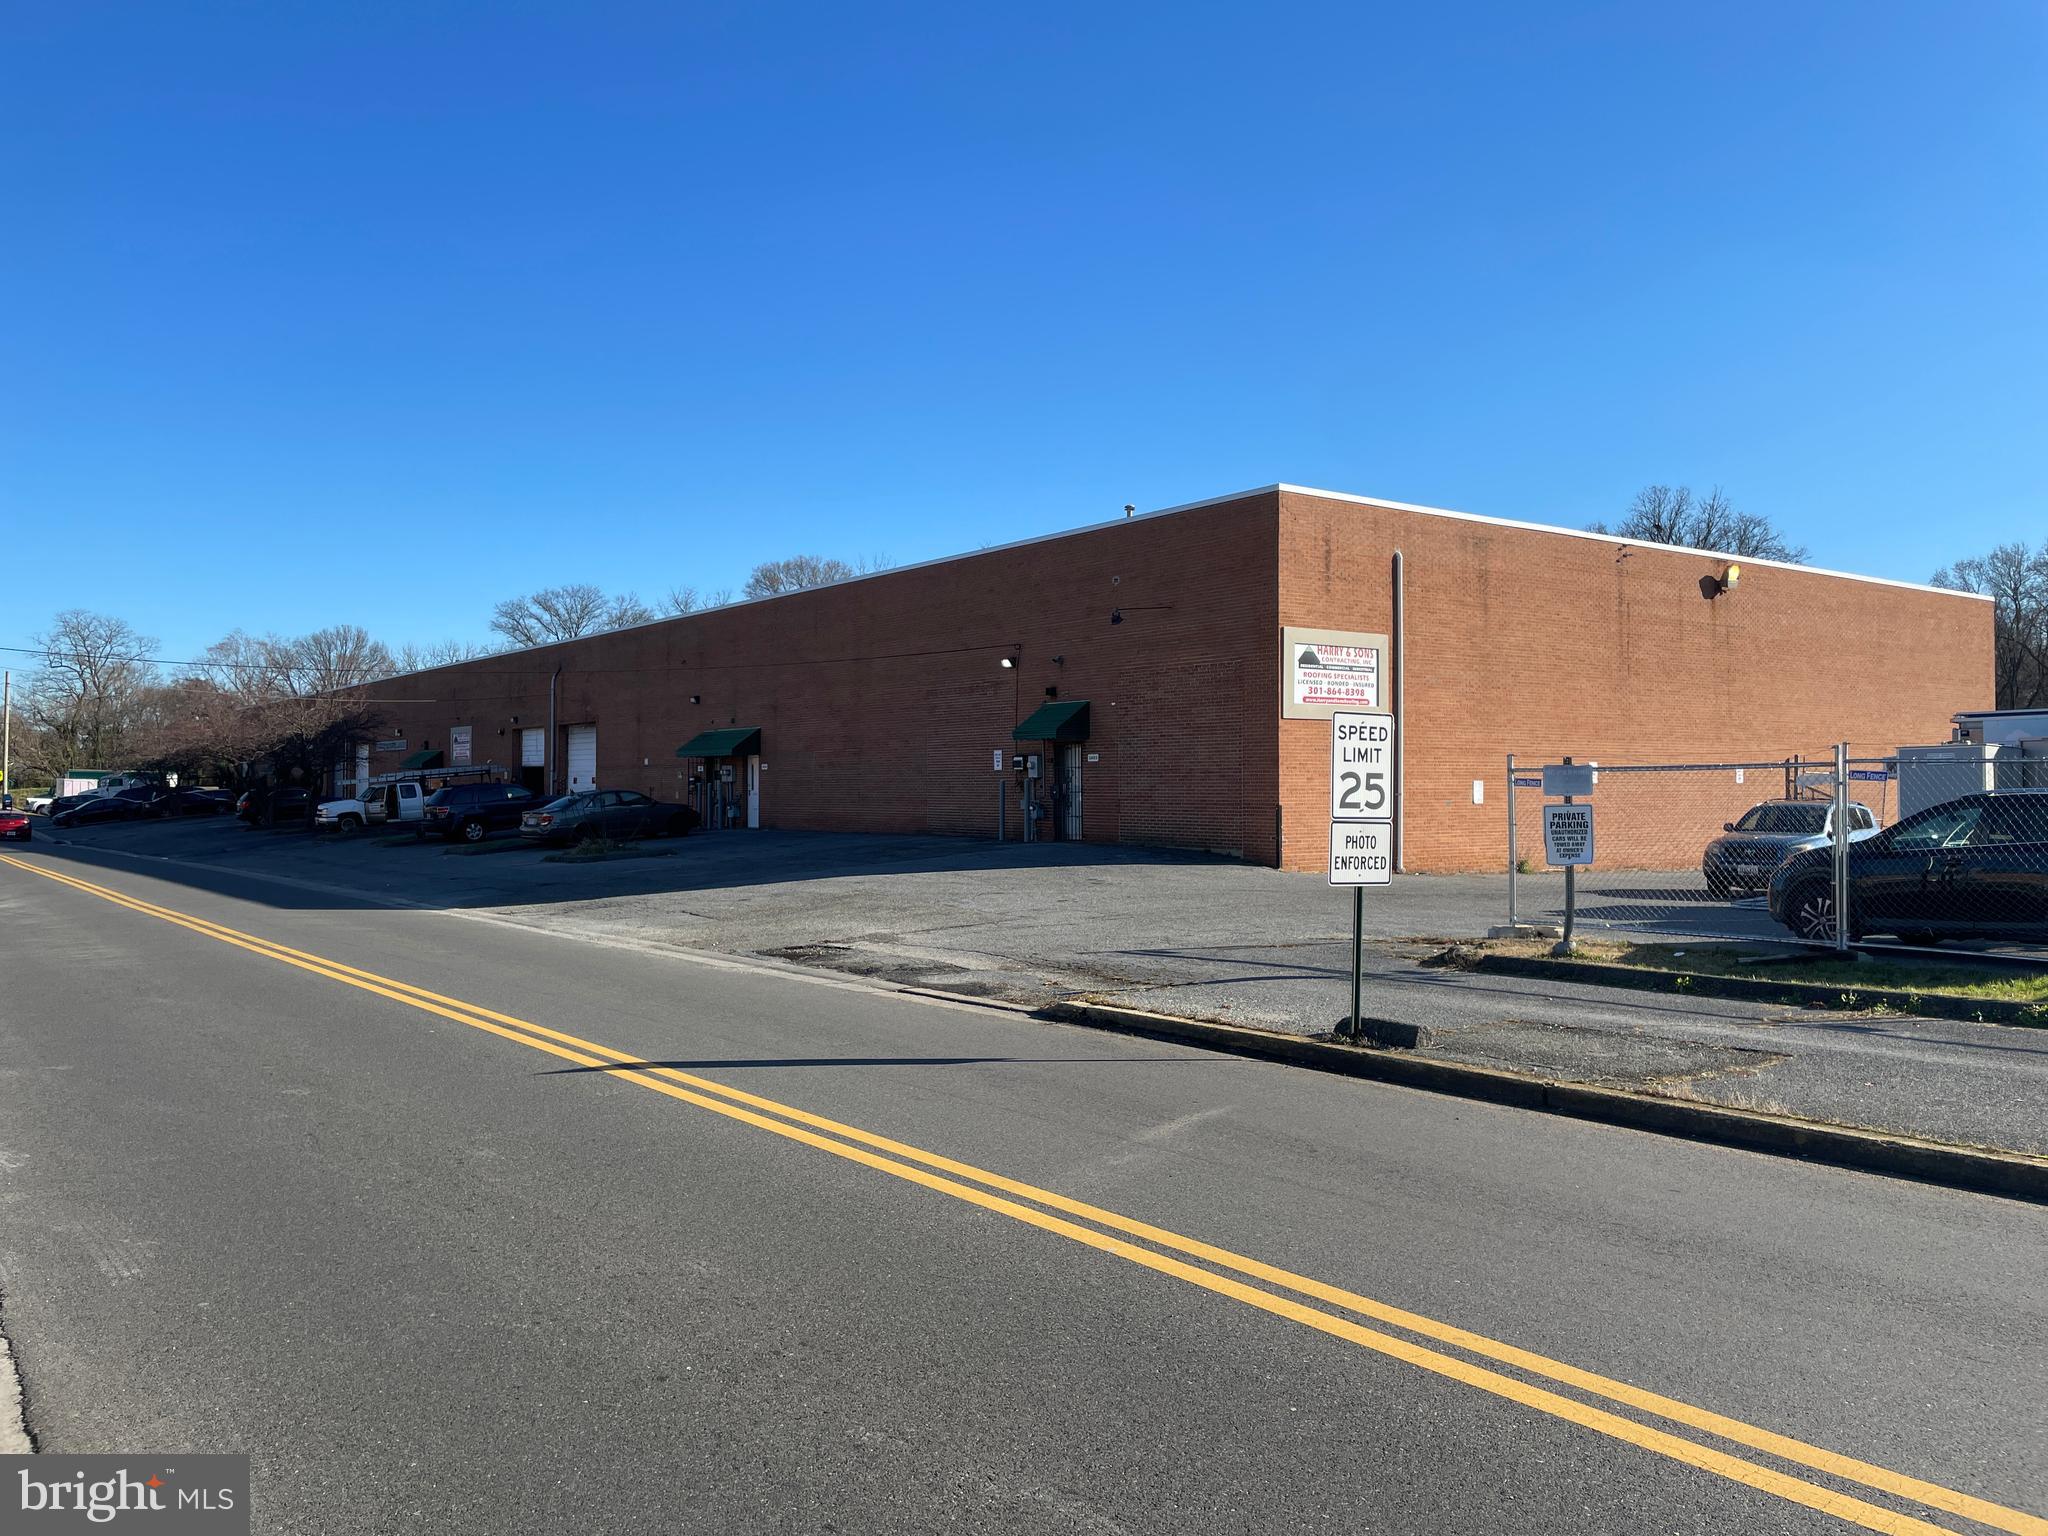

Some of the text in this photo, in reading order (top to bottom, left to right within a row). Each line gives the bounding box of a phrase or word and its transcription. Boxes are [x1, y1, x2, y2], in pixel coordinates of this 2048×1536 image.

[1317, 645, 1374, 659] HARRY & SONS
[1303, 671, 1370, 681] ROOFING SPECIALISTS
[1338, 724, 1388, 742] SPEED
[1343, 747, 1382, 763] LIMIT
[1866, 772, 1886, 780] FENCE
[1339, 771, 1386, 810] 25
[1552, 812, 1586, 821] PRIVATE
[1550, 820, 1589, 829] PARKING
[1345, 835, 1377, 850] PHOTO
[1334, 856, 1387, 870] ENFORCED
